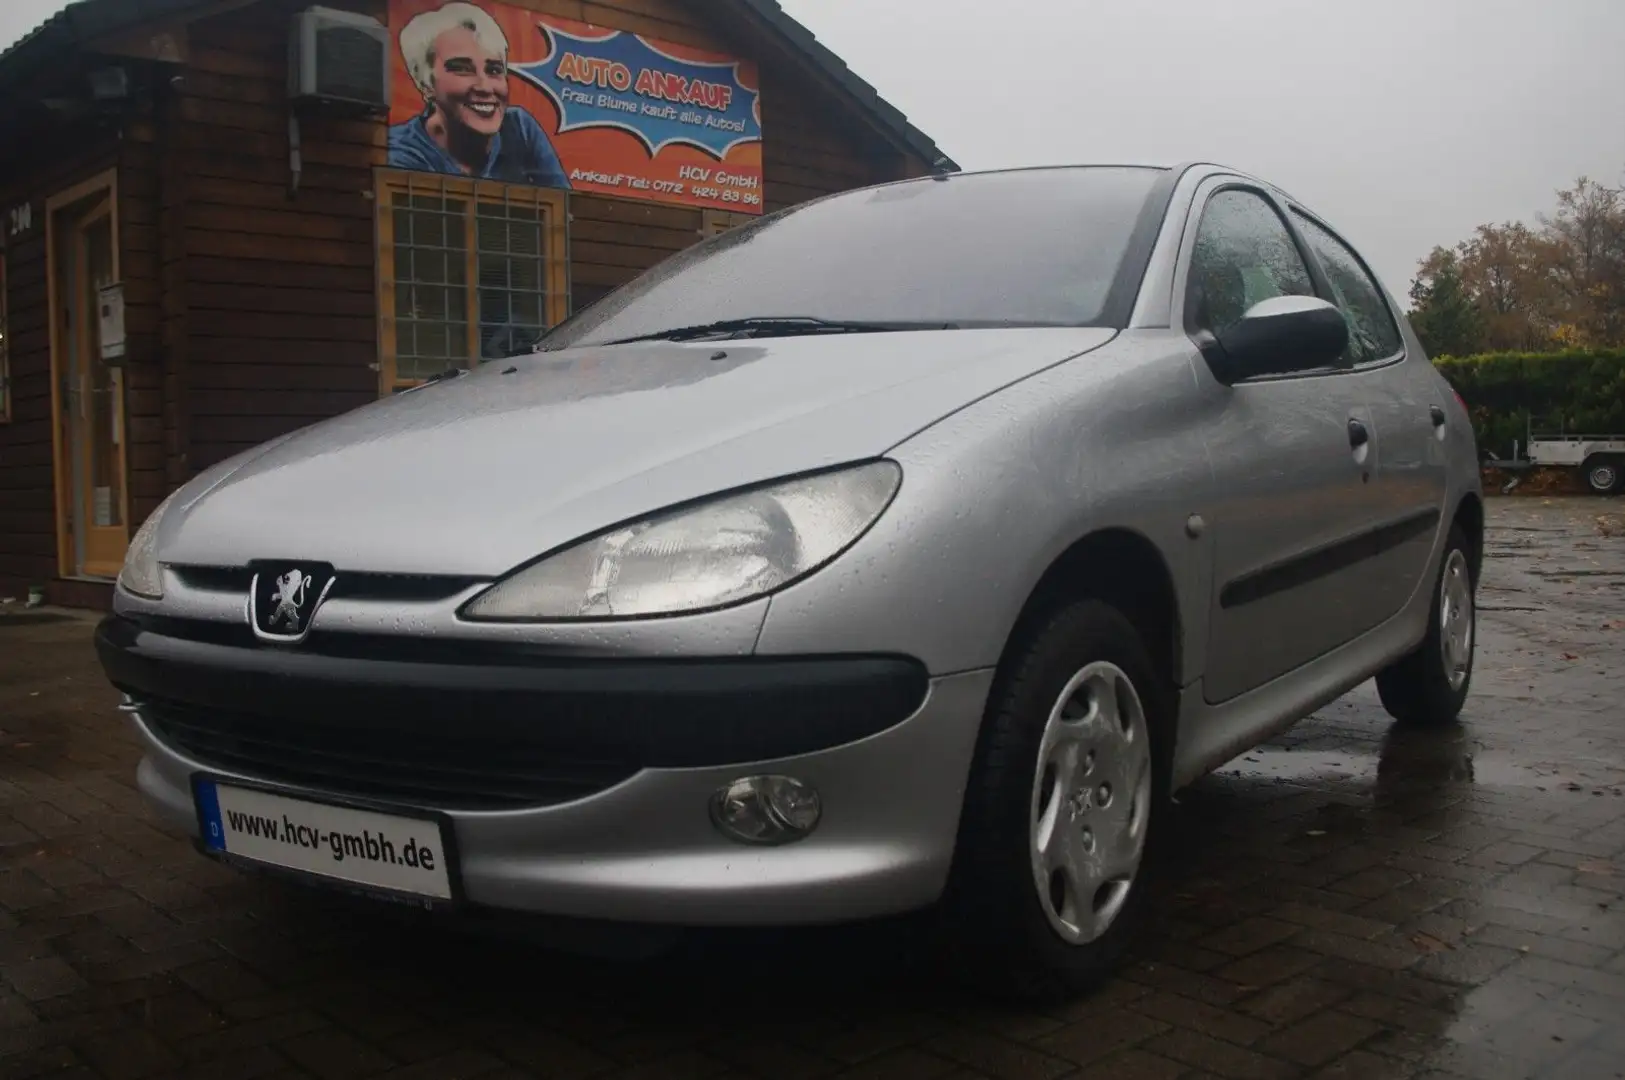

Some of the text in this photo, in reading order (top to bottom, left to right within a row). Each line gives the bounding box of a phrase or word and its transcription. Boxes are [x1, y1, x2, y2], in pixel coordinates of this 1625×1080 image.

[556, 52, 732, 111] AUTO ANKAUF
[561, 87, 746, 132] Frau Blume kauft alle Autos!
[653, 179, 684, 194] 0172
[692, 186, 719, 199] 424
[680, 165, 758, 188] HCV GmbH
[211, 821, 219, 837] D
[227, 809, 435, 871] www.hcv-gmbh.de
